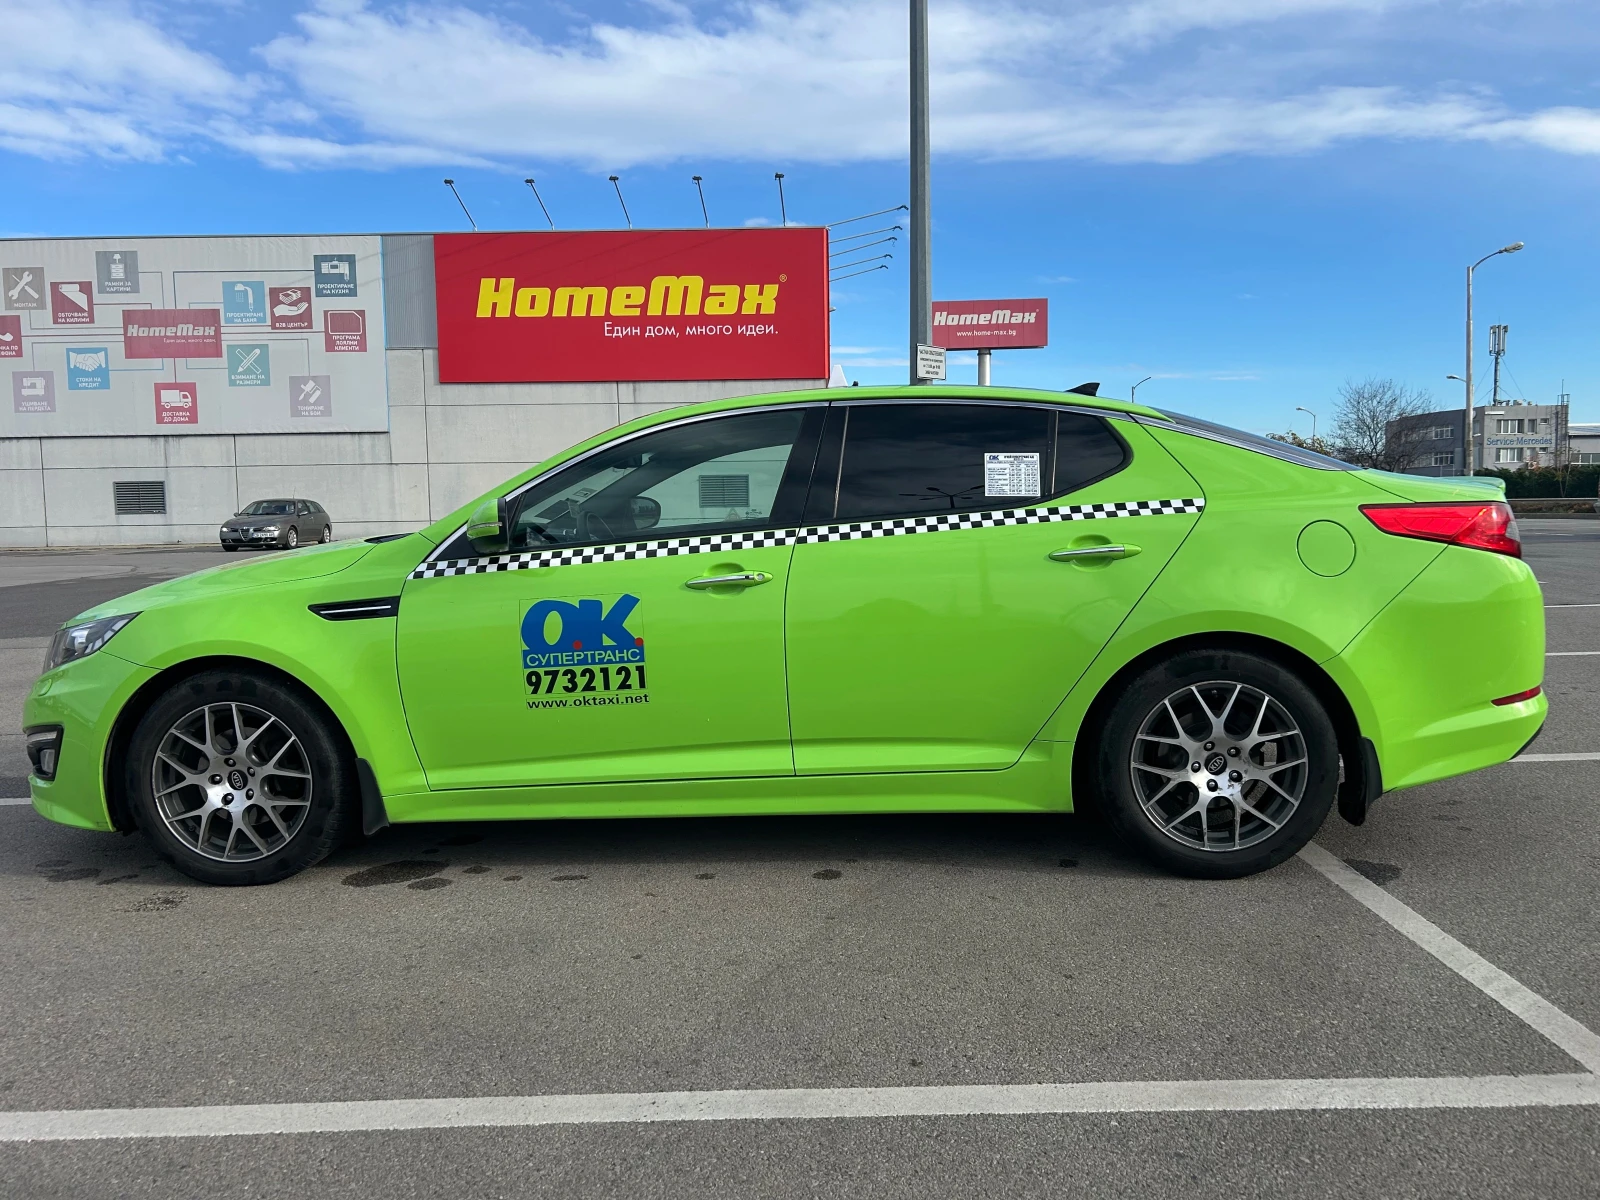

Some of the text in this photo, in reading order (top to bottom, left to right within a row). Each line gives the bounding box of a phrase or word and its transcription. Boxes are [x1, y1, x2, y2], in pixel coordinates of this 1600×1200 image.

[476, 275, 780, 318] HomeMax
[933, 310, 1036, 326] HomeMax
[127, 324, 215, 336] HomeMax
[604, 322, 779, 338] Един дом, много идеи.
[1486, 437, 1553, 446] Service Mercedes
[526, 649, 640, 666] СУПЕРТРАНС
[526, 665, 646, 694] 9732121
[527, 694, 650, 709] www.oktaxi.net
[1210, 759, 1222, 771] KIA
[233, 774, 242, 786] KIA
